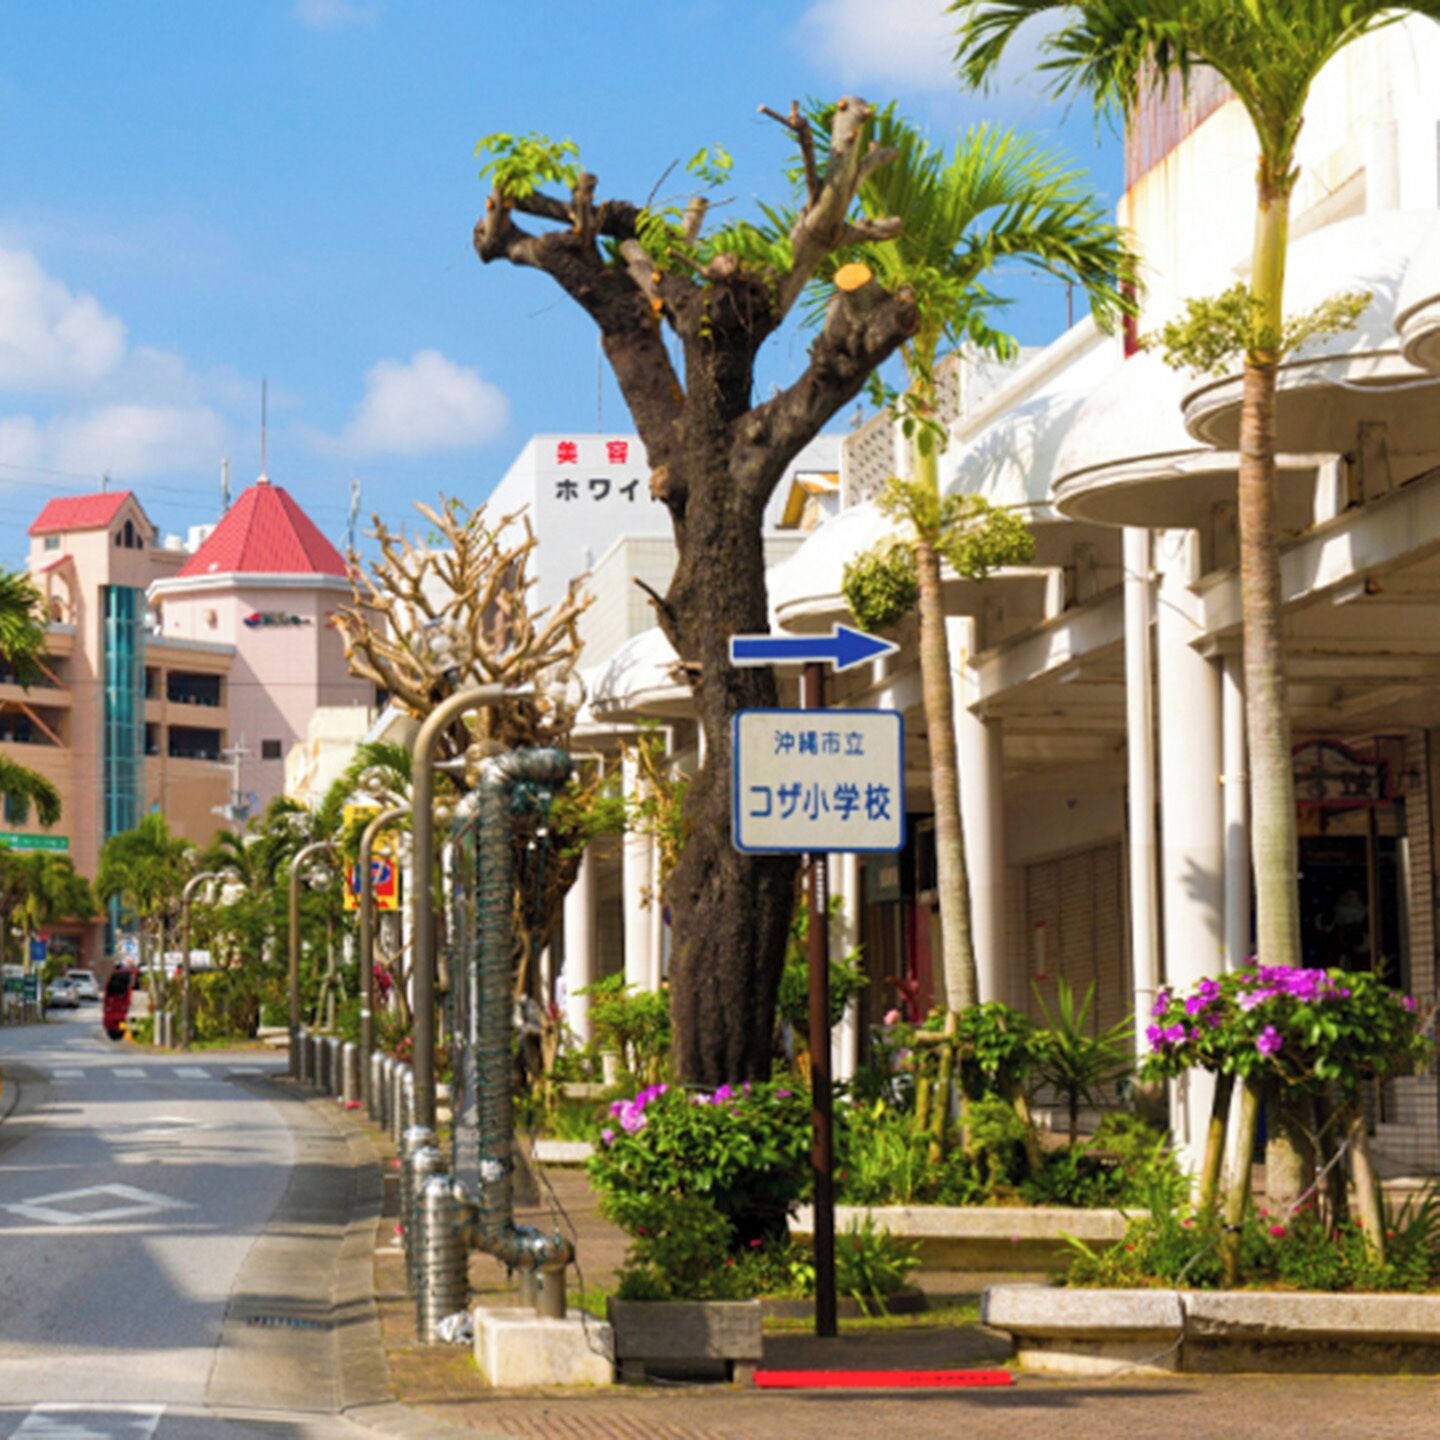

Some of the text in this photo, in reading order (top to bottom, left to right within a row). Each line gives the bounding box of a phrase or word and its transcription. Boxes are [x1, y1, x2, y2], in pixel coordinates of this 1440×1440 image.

[557, 441, 628, 464] 美容
[556, 478, 658, 502] ホワイ
[774, 730, 864, 755] 沖縄市立
[749, 783, 891, 821] コザ小学校
